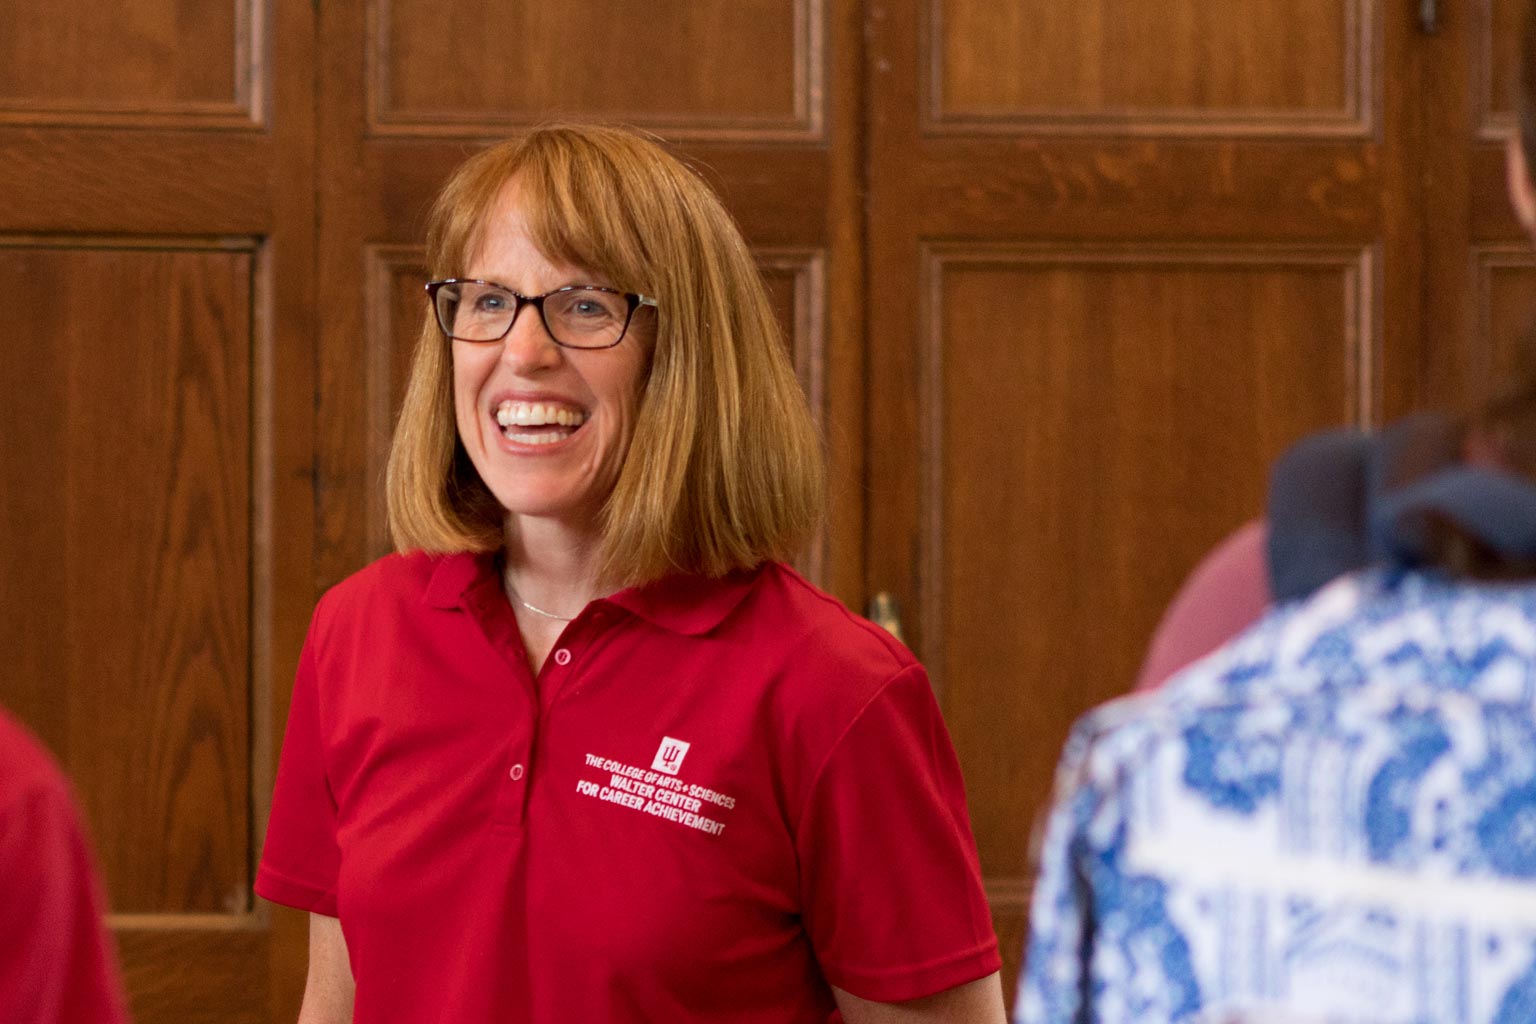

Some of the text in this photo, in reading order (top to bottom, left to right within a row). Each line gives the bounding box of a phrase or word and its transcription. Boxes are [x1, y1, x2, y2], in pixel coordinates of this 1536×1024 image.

[576, 780, 726, 836] FOR CAREER ACHIEVEMENT
[585, 753, 603, 769] THE
[603, 758, 644, 780] COLLEGE
[644, 771, 658, 784] OF
[656, 775, 683, 792] ARTS
[688, 784, 736, 810] SCIENCES
[609, 774, 702, 813] WALTER CENTER
